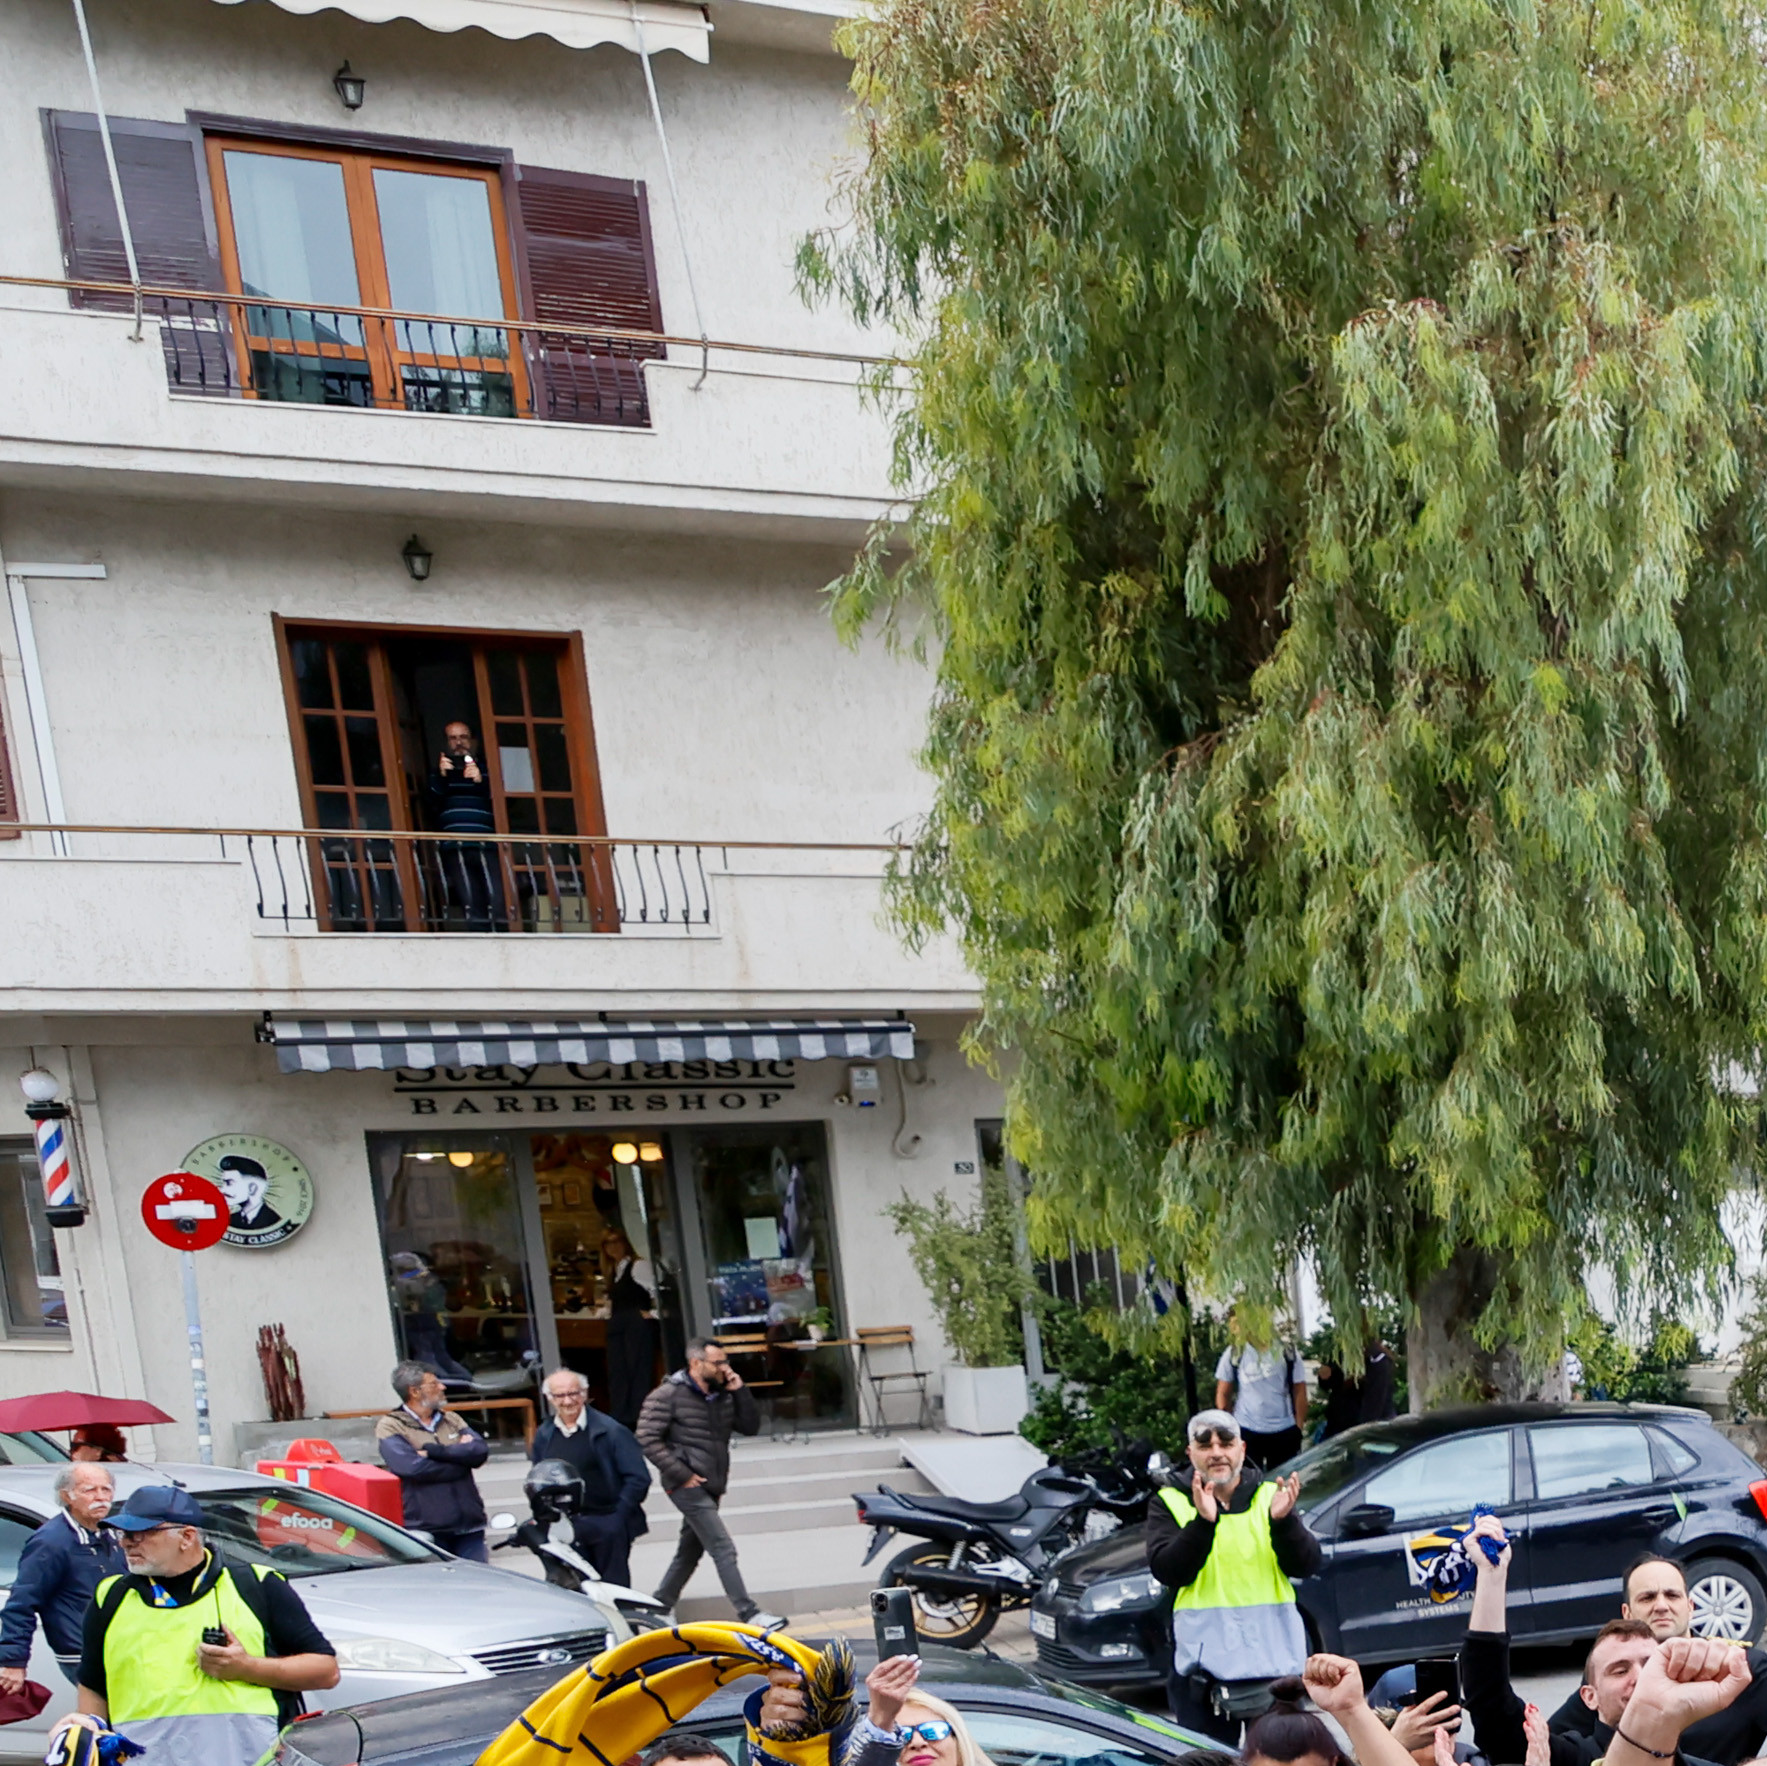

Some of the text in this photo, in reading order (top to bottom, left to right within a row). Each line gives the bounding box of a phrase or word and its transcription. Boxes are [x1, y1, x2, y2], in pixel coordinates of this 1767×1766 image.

[410, 1092, 783, 1115] BARBERSHOP
[1395, 1596, 1432, 1610] HEALTH
[1418, 1603, 1461, 1618] SYSTEMS
